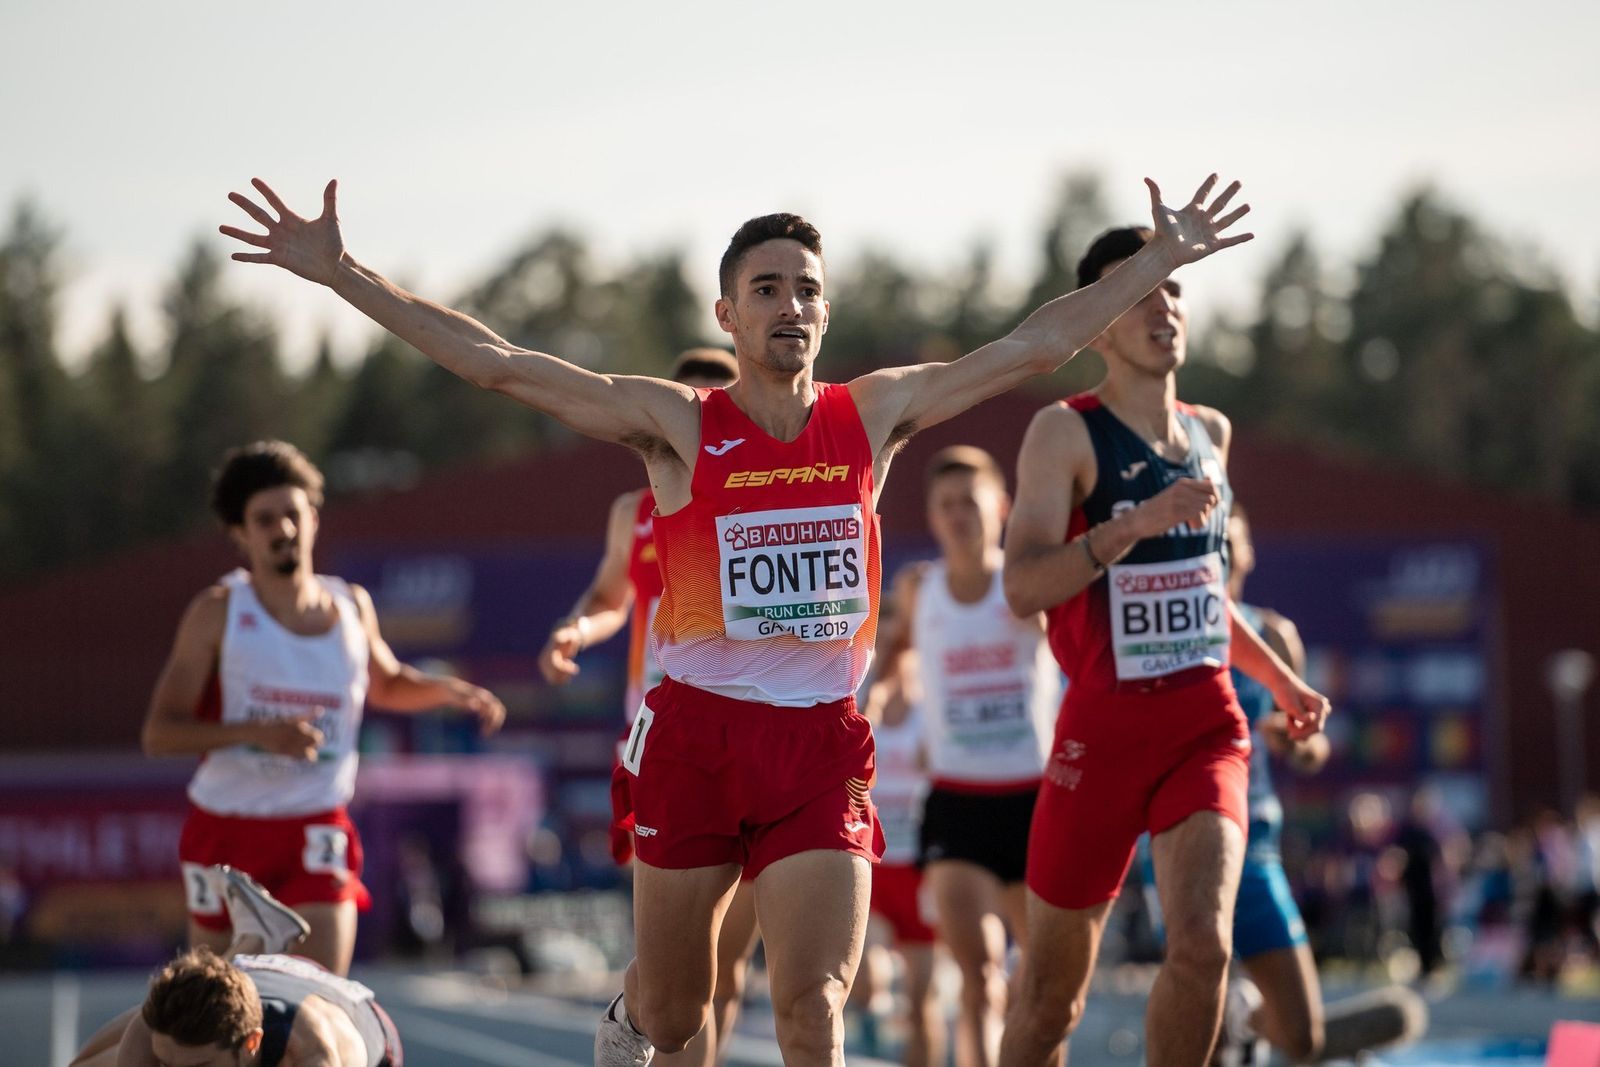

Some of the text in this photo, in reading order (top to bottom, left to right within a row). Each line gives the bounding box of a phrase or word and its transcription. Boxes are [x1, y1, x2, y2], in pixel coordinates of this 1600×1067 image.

[724, 462, 850, 489] ESPAÑA
[748, 519, 859, 546] BAUHAUS
[728, 547, 860, 597] FONTES
[764, 606, 793, 619] RUN
[1122, 593, 1220, 635] BIBIC
[814, 621, 848, 638] 2019
[629, 717, 646, 763] 1
